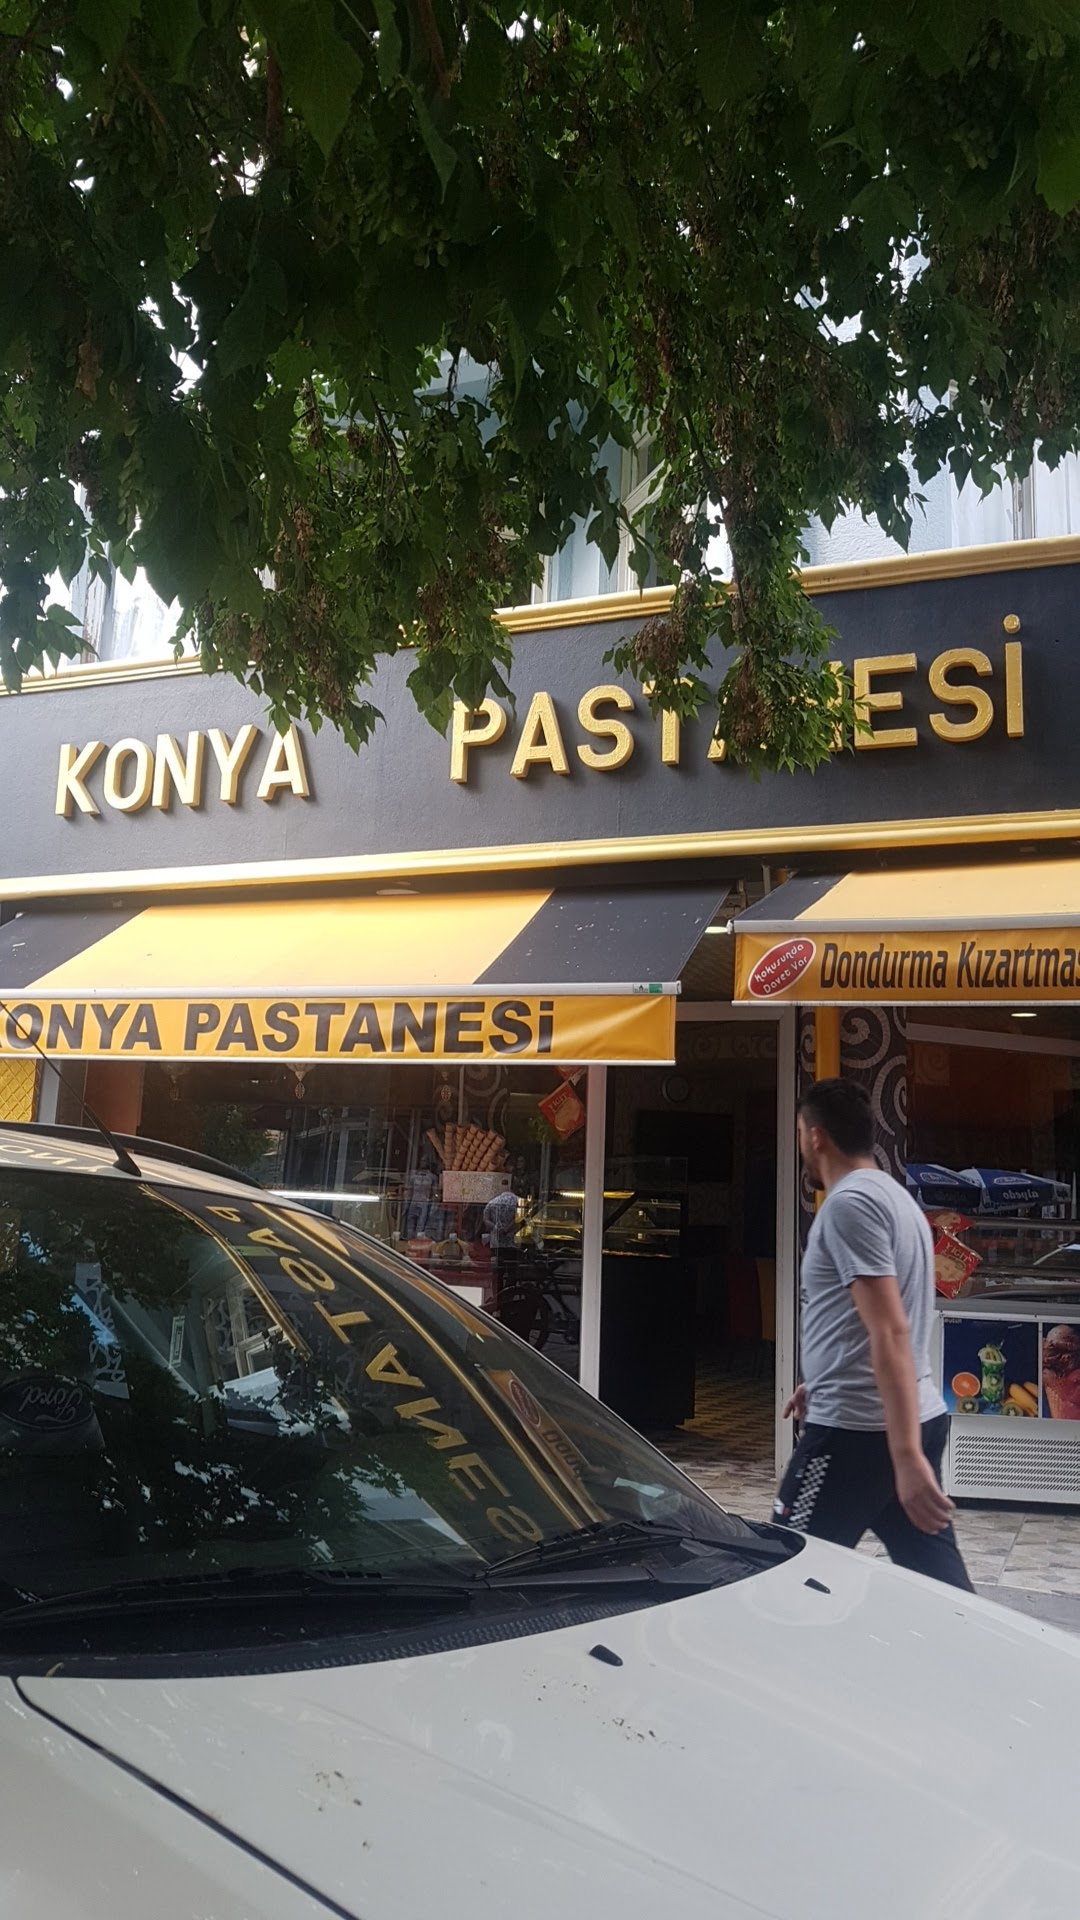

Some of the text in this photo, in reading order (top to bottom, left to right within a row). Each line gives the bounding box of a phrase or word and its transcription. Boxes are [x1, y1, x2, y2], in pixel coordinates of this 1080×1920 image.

[55, 614, 1024, 816] KONYA PASTESİ
[820, 941, 1080, 989] Dondurma Kızartma
[0, 1003, 162, 1050] ONYA
